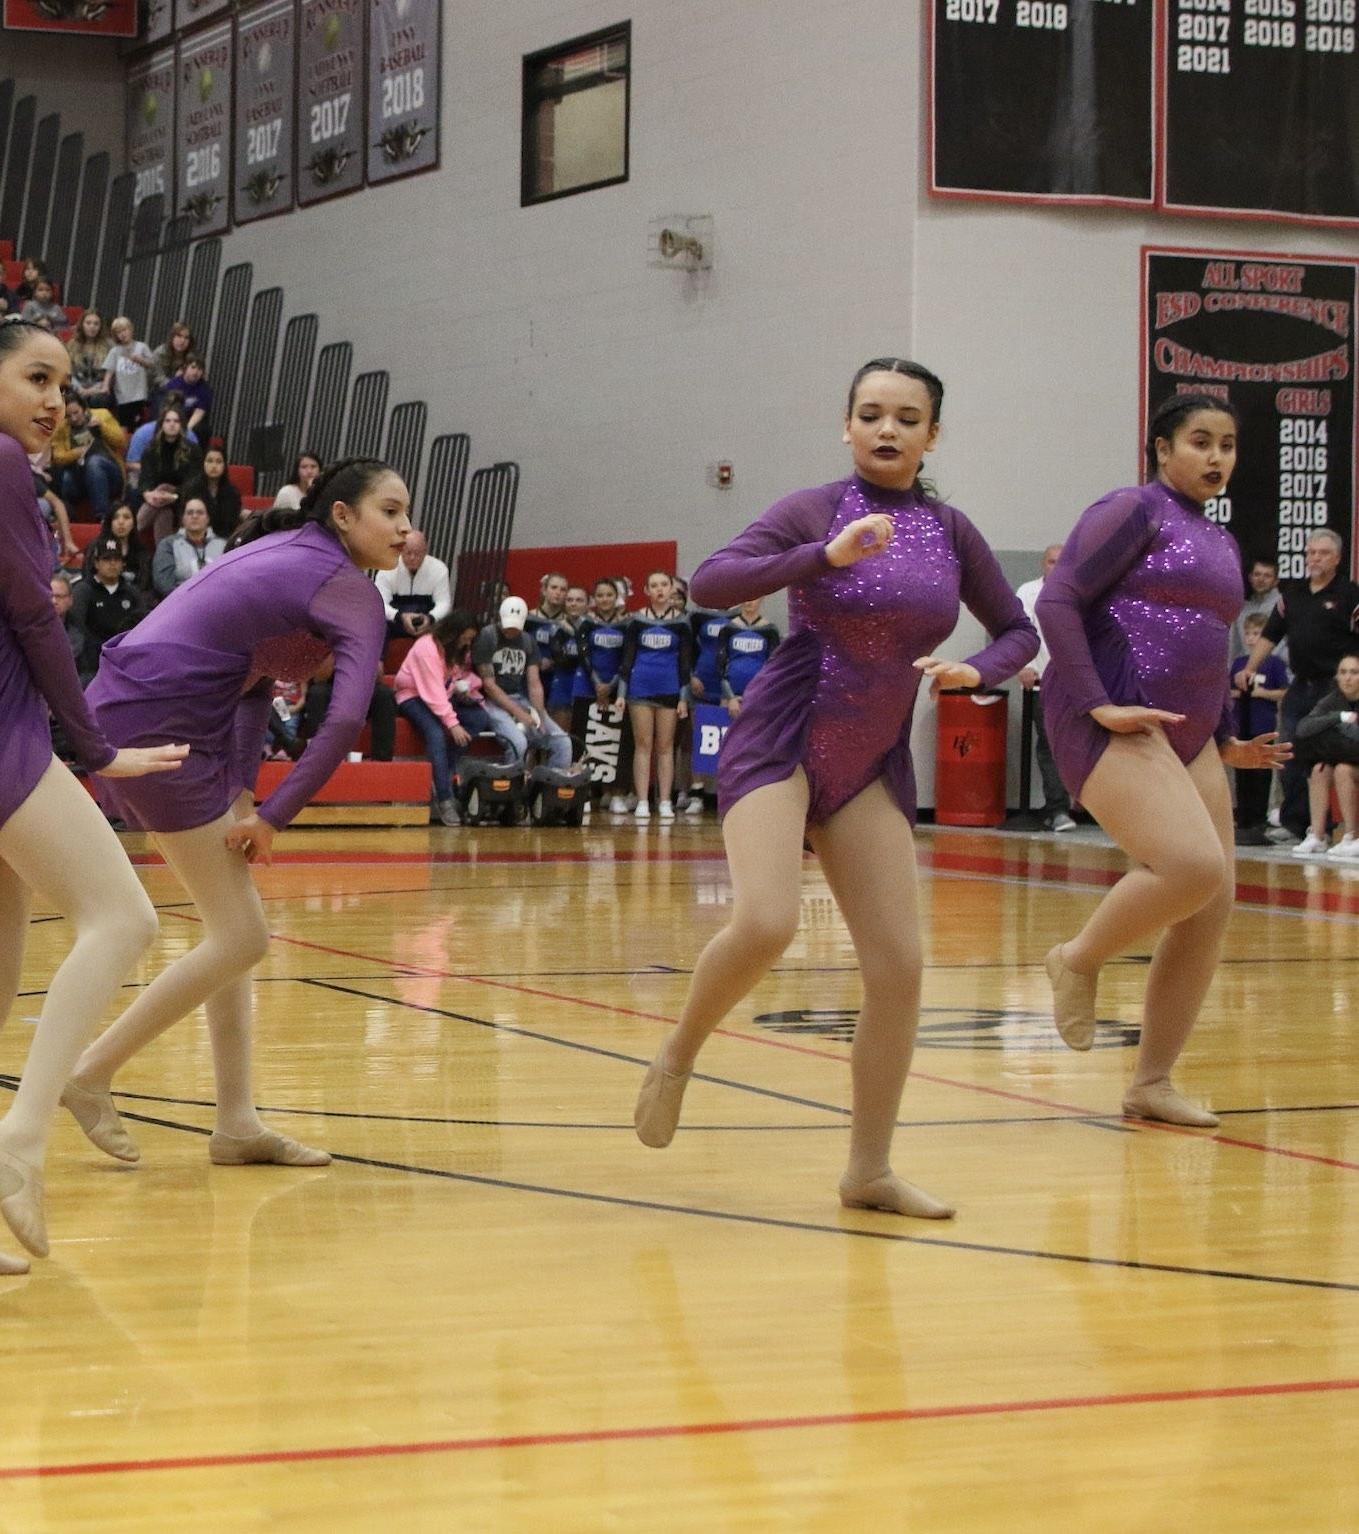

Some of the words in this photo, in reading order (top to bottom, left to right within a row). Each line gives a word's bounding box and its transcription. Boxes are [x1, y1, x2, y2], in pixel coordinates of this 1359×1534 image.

[1016, 1, 1068, 31] 2018
[1305, 0, 1356, 24] 2016
[1177, 13, 1231, 43] 2017
[1243, 19, 1296, 48] 2018
[1305, 25, 1355, 53] 2019
[1177, 44, 1231, 74] 2021
[382, 67, 425, 119] 2018
[310, 93, 352, 144] 2017
[247, 118, 282, 165] 2017
[186, 143, 221, 187] 2016
[1201, 261, 1239, 290] ALL
[1240, 264, 1306, 293] SPORT
[1154, 291, 1202, 330] ESD
[1203, 291, 1351, 340] CONFERENCE
[1153, 337, 1350, 382] CHAMPIONSHIPS
[1275, 387, 1331, 417] GIRLS
[1279, 418, 1328, 445] 2014
[1279, 445, 1328, 472] 2016
[1279, 472, 1328, 499] 2017
[1278, 499, 1328, 526] 2018
[585, 702, 624, 783] CAVS
[699, 725, 729, 755] B
